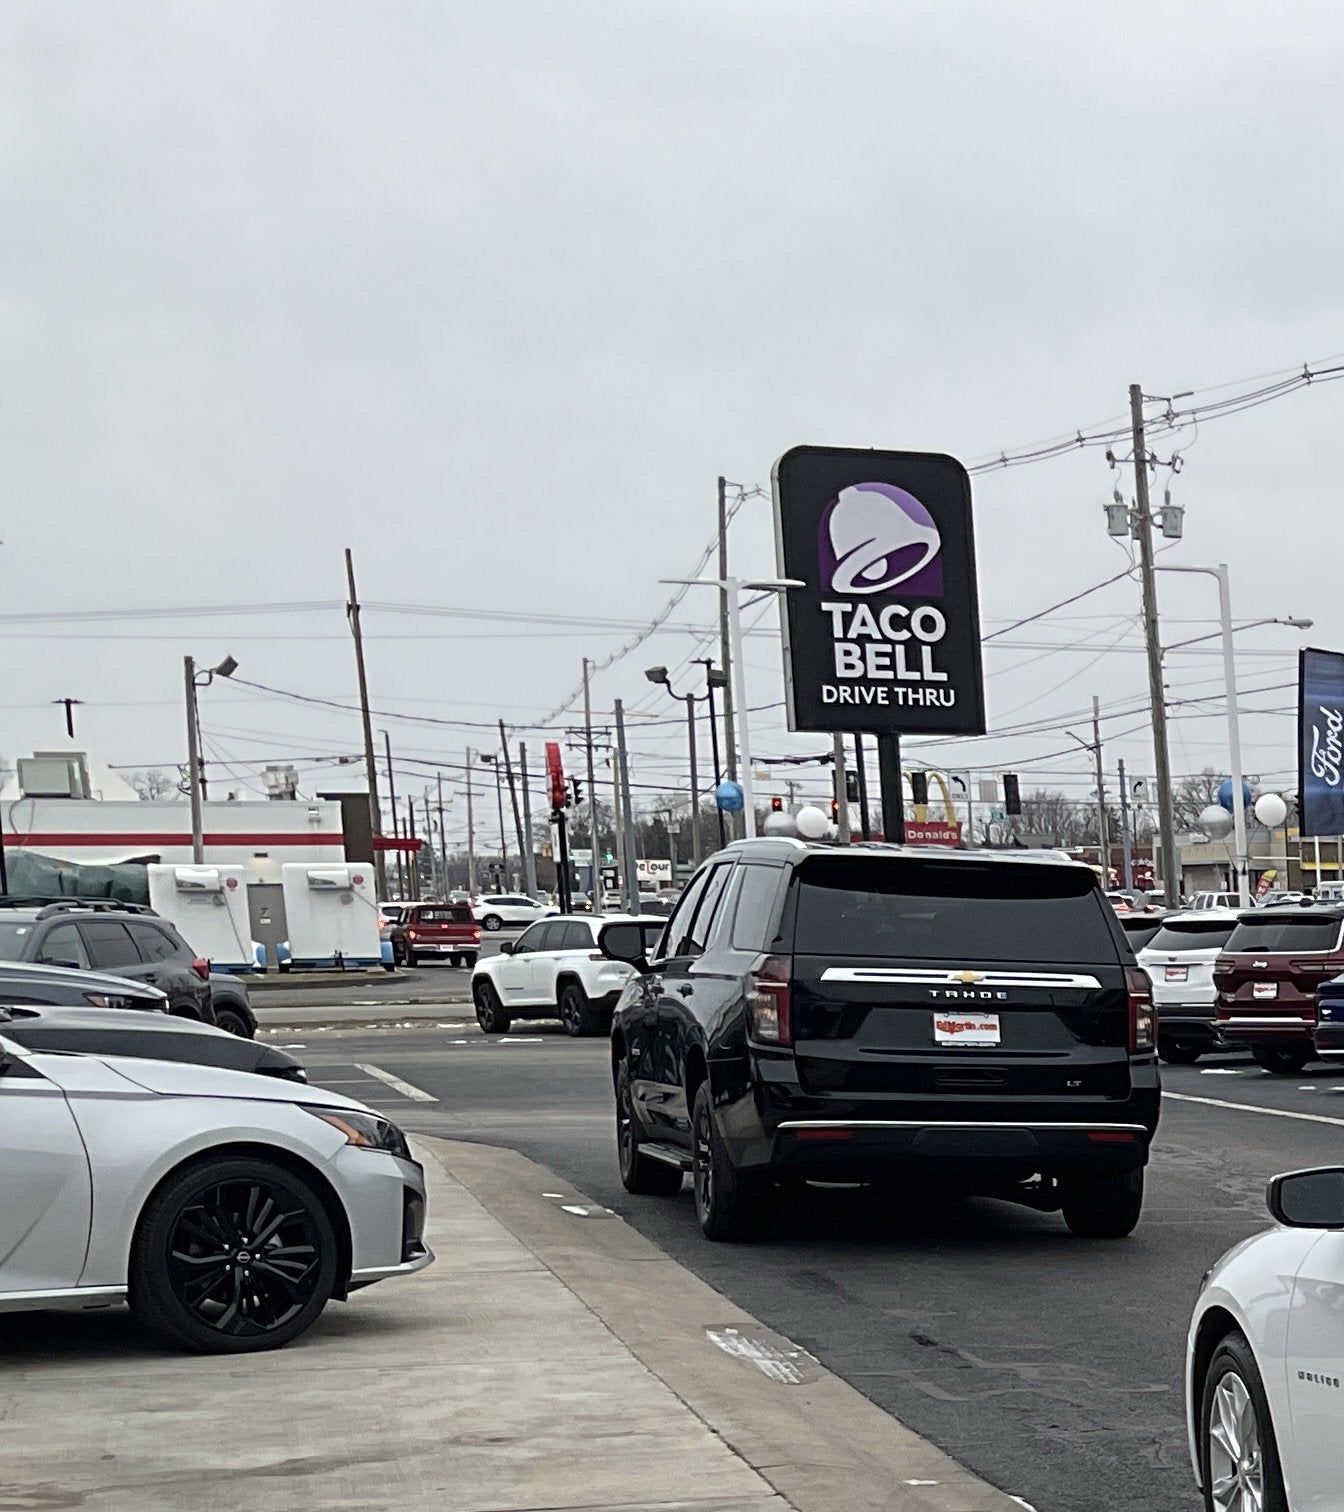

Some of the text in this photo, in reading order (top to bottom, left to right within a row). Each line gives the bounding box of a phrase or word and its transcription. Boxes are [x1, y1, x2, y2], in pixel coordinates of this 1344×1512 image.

[821, 602, 946, 642] TACO
[834, 642, 948, 681] BELL
[822, 685, 955, 706] DRIVE THRU
[1311, 706, 1343, 786] Ford
[905, 829, 958, 840] Donald's
[928, 990, 1007, 999] TAHOE
